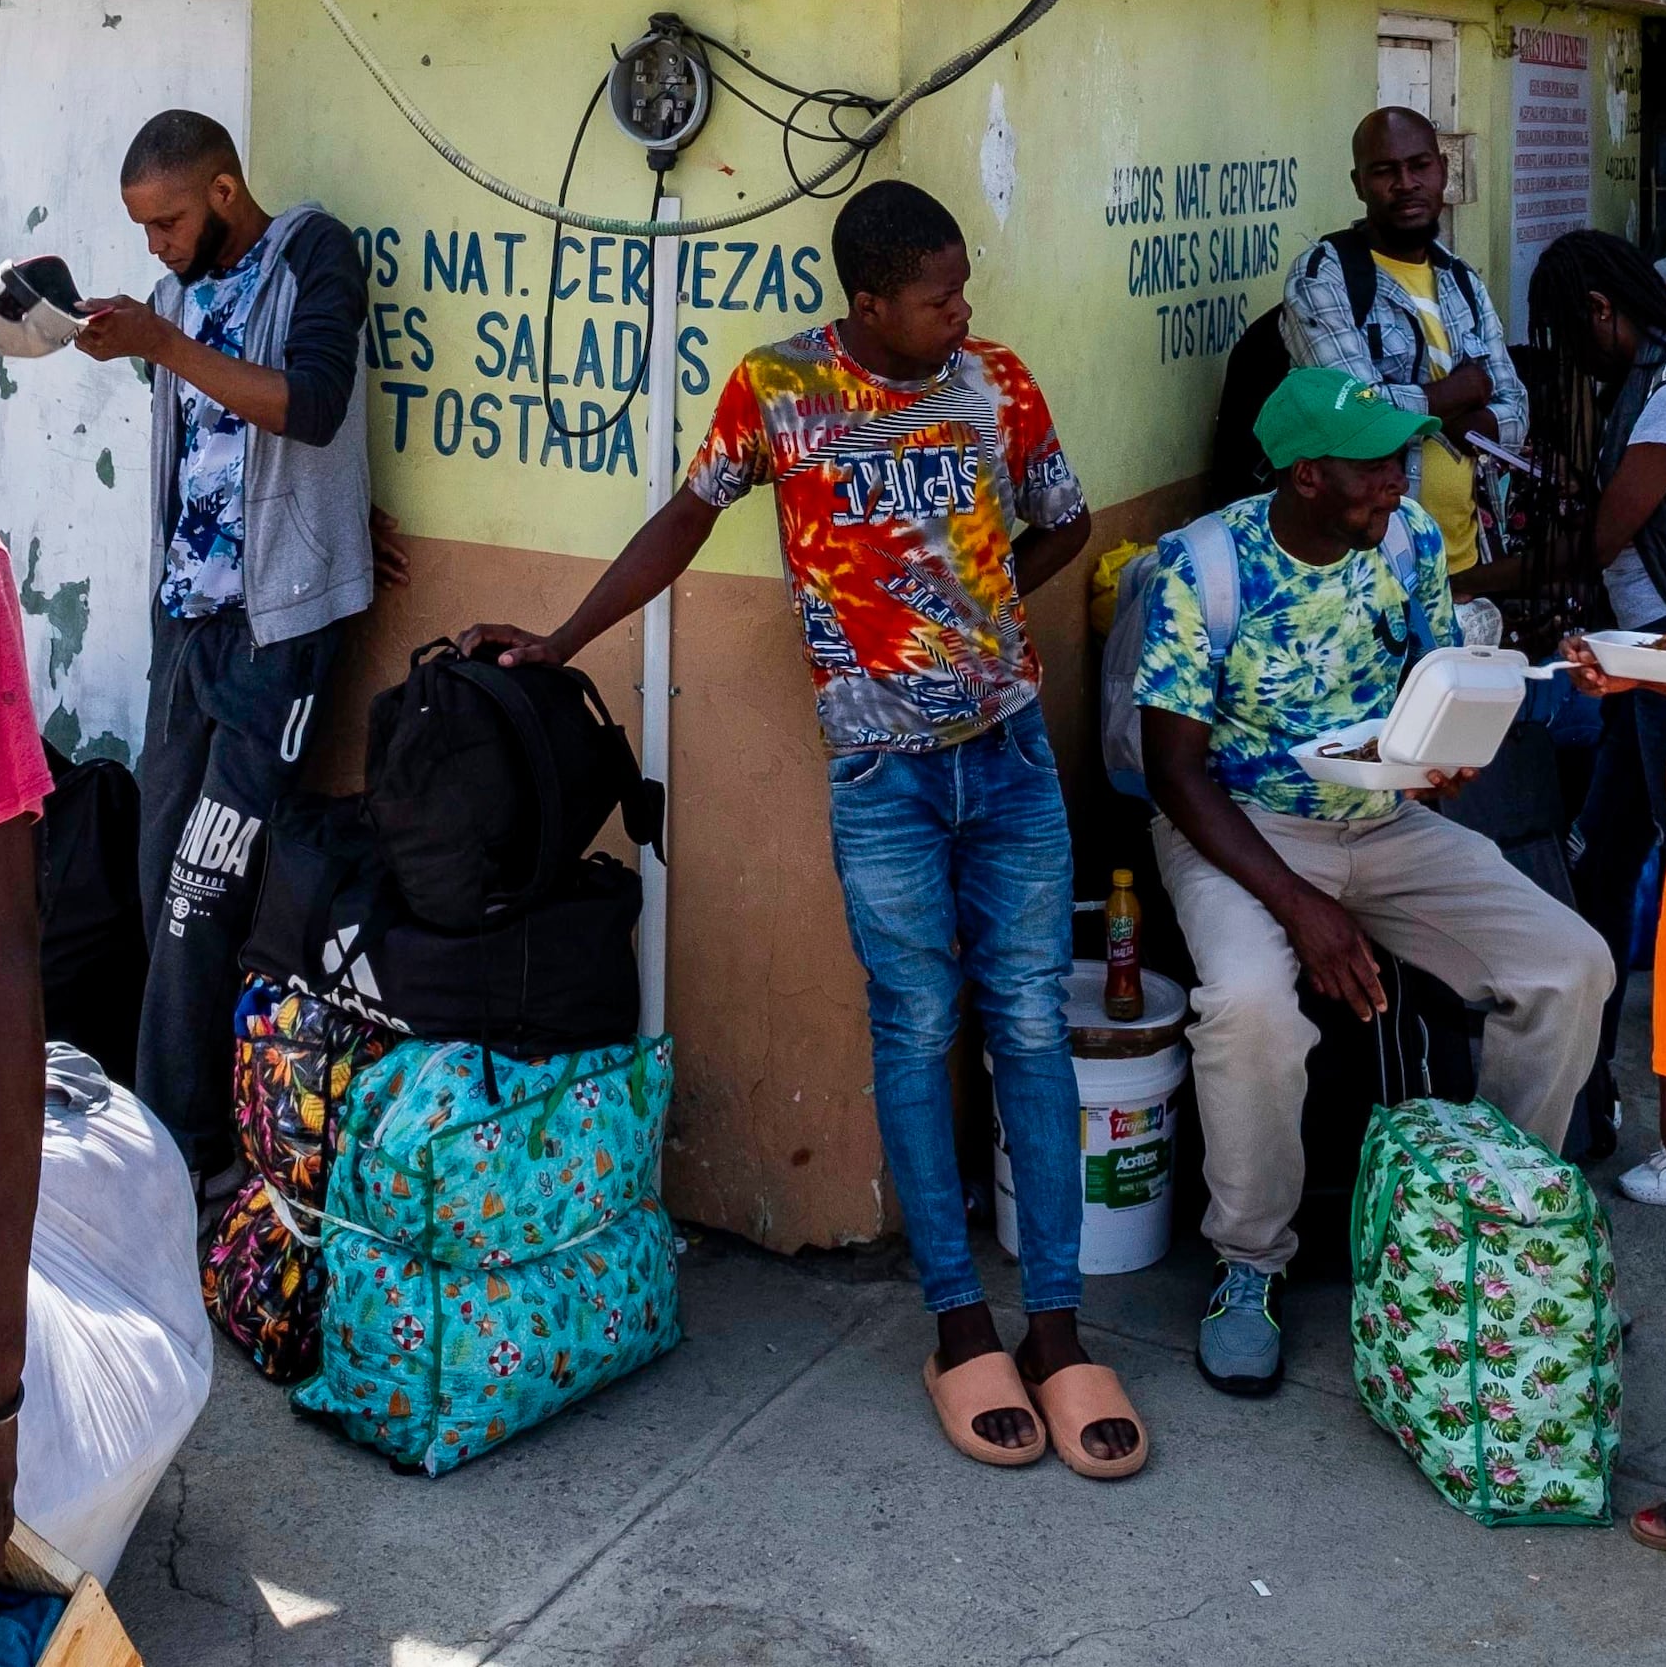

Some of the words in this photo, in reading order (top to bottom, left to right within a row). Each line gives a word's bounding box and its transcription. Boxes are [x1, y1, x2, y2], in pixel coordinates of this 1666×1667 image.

[1175, 163, 1211, 220] NAT.
[1219, 157, 1297, 216] CERVEZAS
[425, 229, 529, 297] NAT.
[1128, 231, 1200, 297] CARNES
[1209, 222, 1279, 283] SALADAS
[475, 311, 710, 395] SALADS
[1114, 1109, 1162, 1134] Tropical
